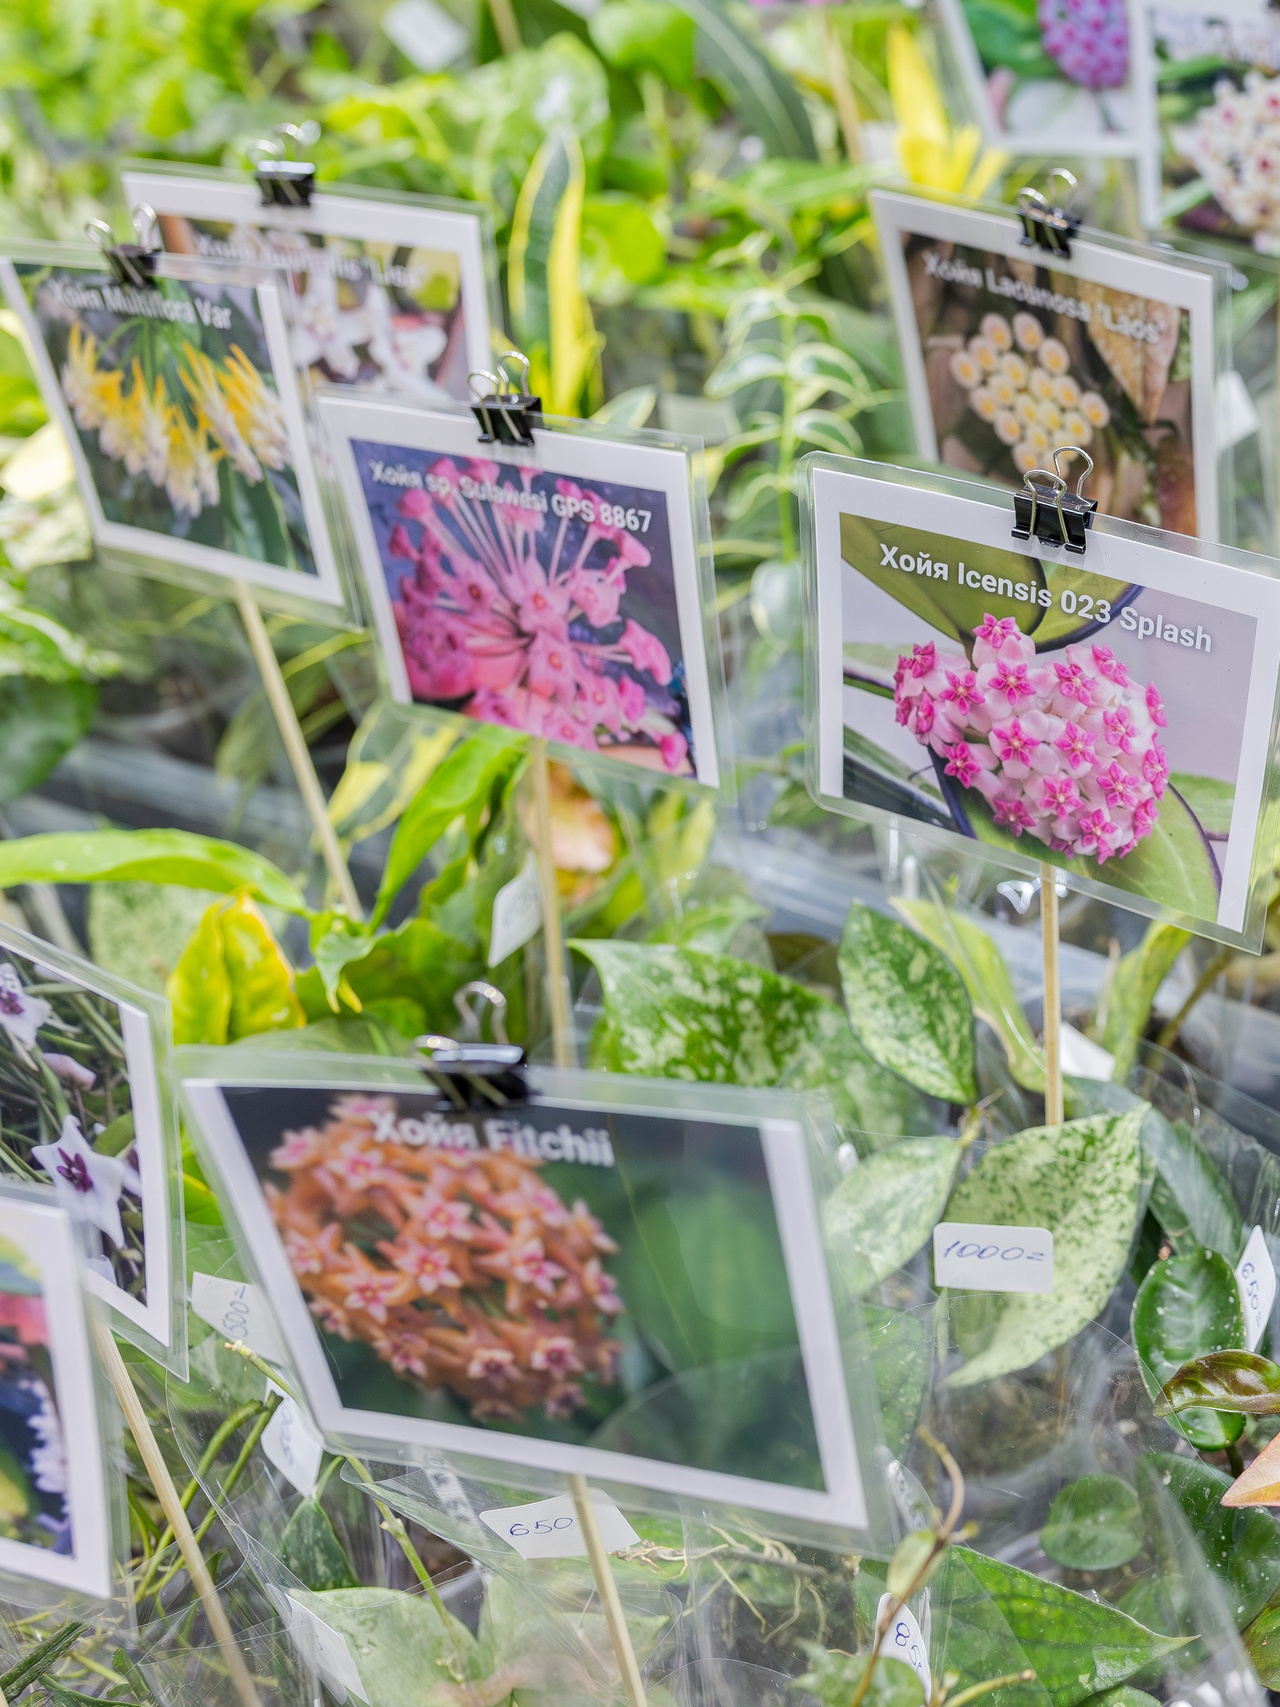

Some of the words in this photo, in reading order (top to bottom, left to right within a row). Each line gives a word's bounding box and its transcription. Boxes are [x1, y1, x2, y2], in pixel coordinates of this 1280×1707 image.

[922, 253, 984, 288] Хойя
[194, 297, 231, 330] Var
[369, 460, 422, 488] Хойя
[552, 494, 595, 523] GPS
[600, 503, 652, 533] 8867
[879, 544, 949, 581] Хойя
[958, 562, 1052, 607] Icensis
[1061, 590, 1112, 624] 023
[1120, 606, 1212, 652] Splash
[370, 1110, 479, 1150] Хойя
[483, 1117, 615, 1168] Fitchii
